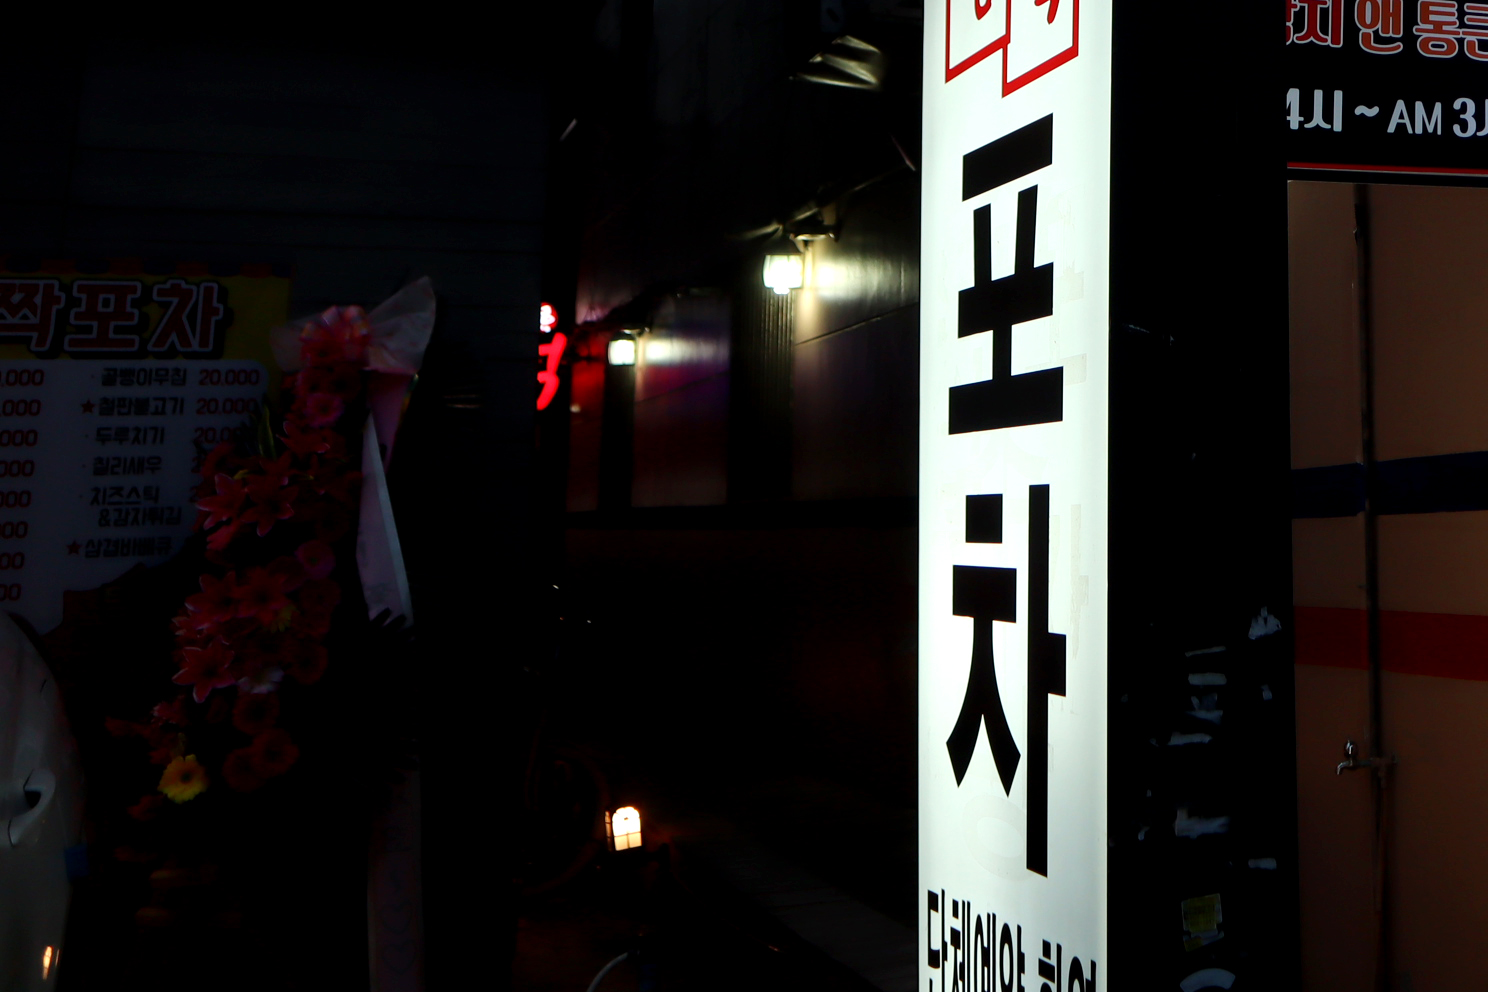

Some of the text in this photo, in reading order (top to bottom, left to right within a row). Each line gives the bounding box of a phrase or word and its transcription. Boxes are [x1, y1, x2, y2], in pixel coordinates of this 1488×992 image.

[1387, 99, 1442, 135] AM
[199, 369, 260, 386] 20.000
[99, 397, 184, 415] 철판불고기
[96, 427, 164, 445] 두루치기
[93, 456, 162, 476] 칠리새우
[90, 486, 159, 506] 치즈스틱
[946, 113, 1067, 878] 포차
